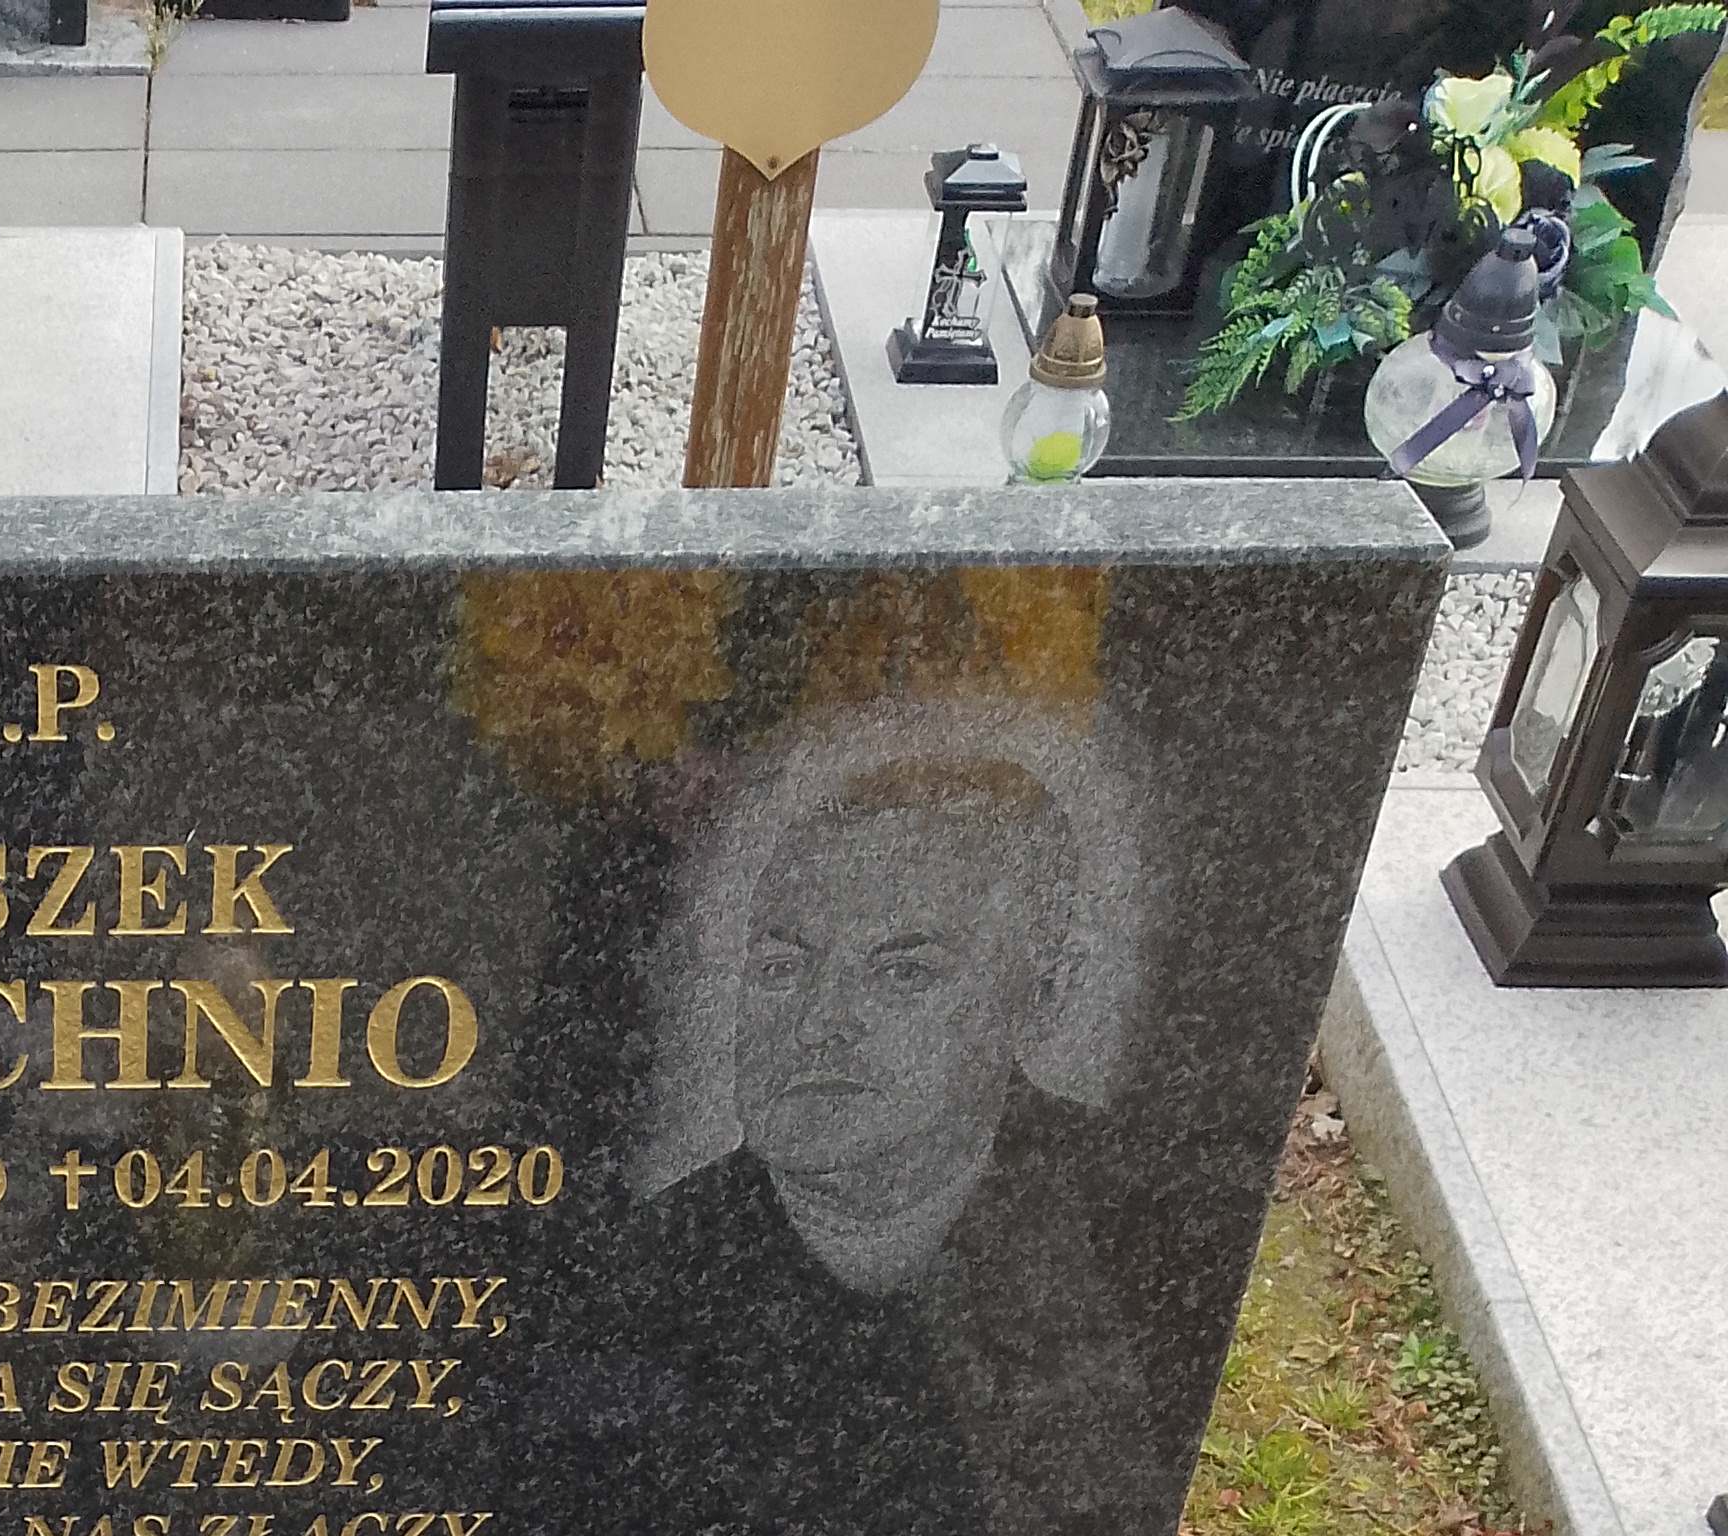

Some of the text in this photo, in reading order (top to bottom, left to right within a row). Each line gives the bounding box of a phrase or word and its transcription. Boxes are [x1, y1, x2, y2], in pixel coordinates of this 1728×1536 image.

[114, 1144, 565, 1209] 04.04.2020
[47, 1360, 176, 1426] SIĘ
[199, 1359, 463, 1425] SĄCZY,
[101, 1437, 384, 1495] WTEDY,
